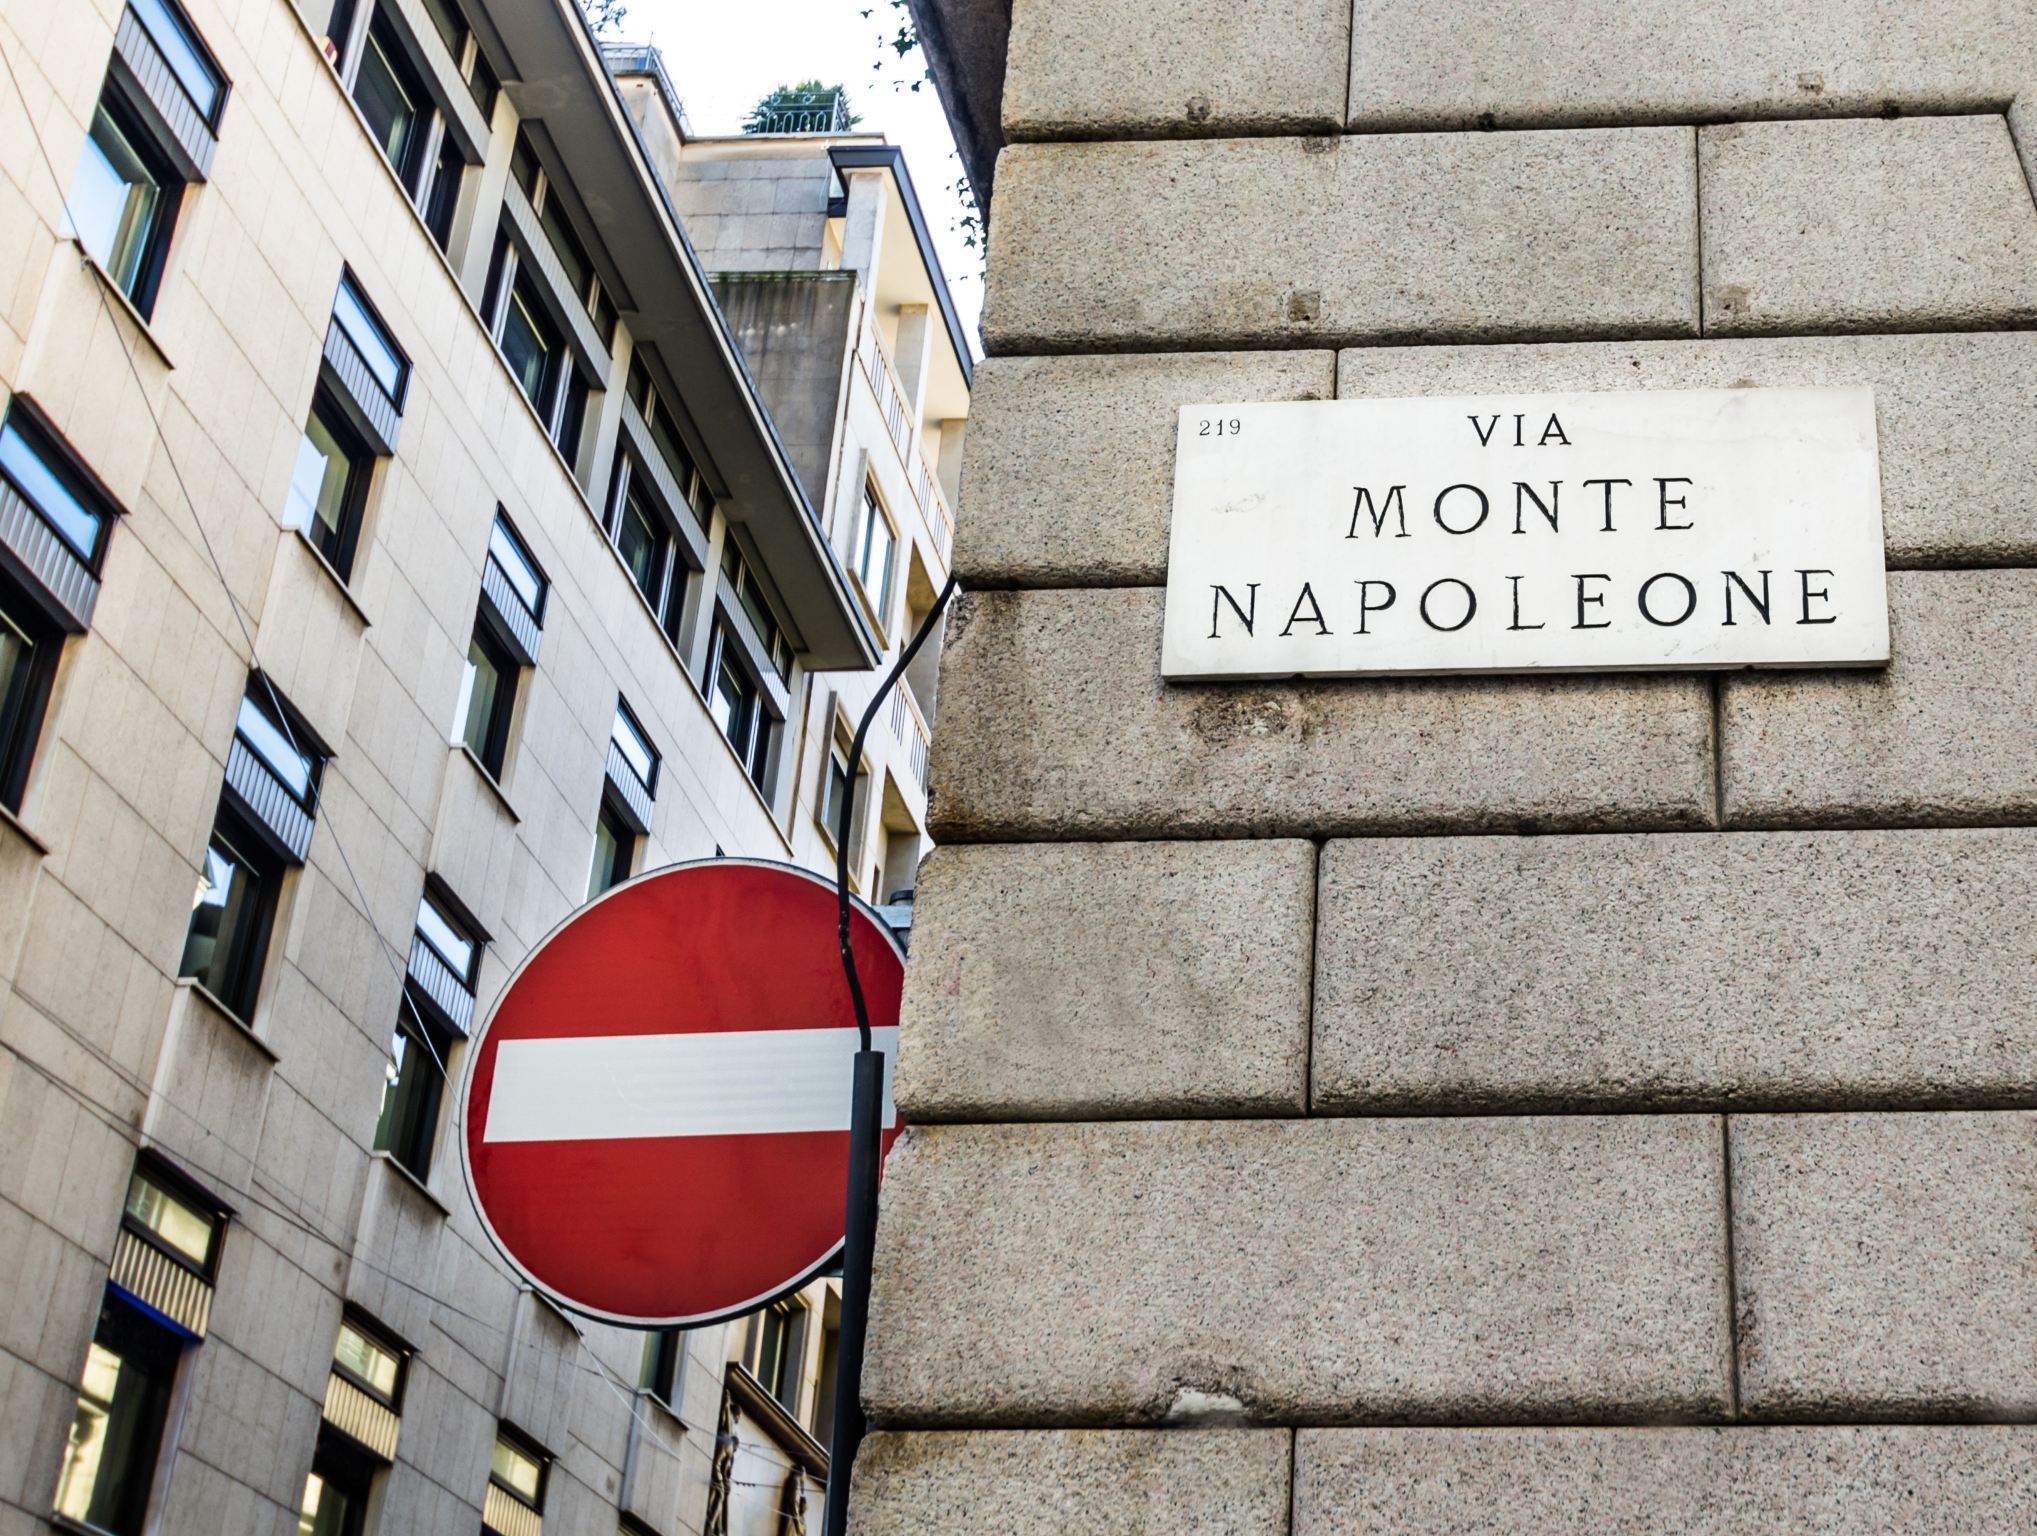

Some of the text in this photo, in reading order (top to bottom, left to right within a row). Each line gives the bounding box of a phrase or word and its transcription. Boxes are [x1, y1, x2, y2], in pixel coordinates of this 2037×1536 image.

[1198, 418, 1241, 436] 219
[1467, 412, 1573, 447] VIA
[1345, 477, 1695, 539] MONTE
[1206, 569, 1837, 639] NAPOLEONE
